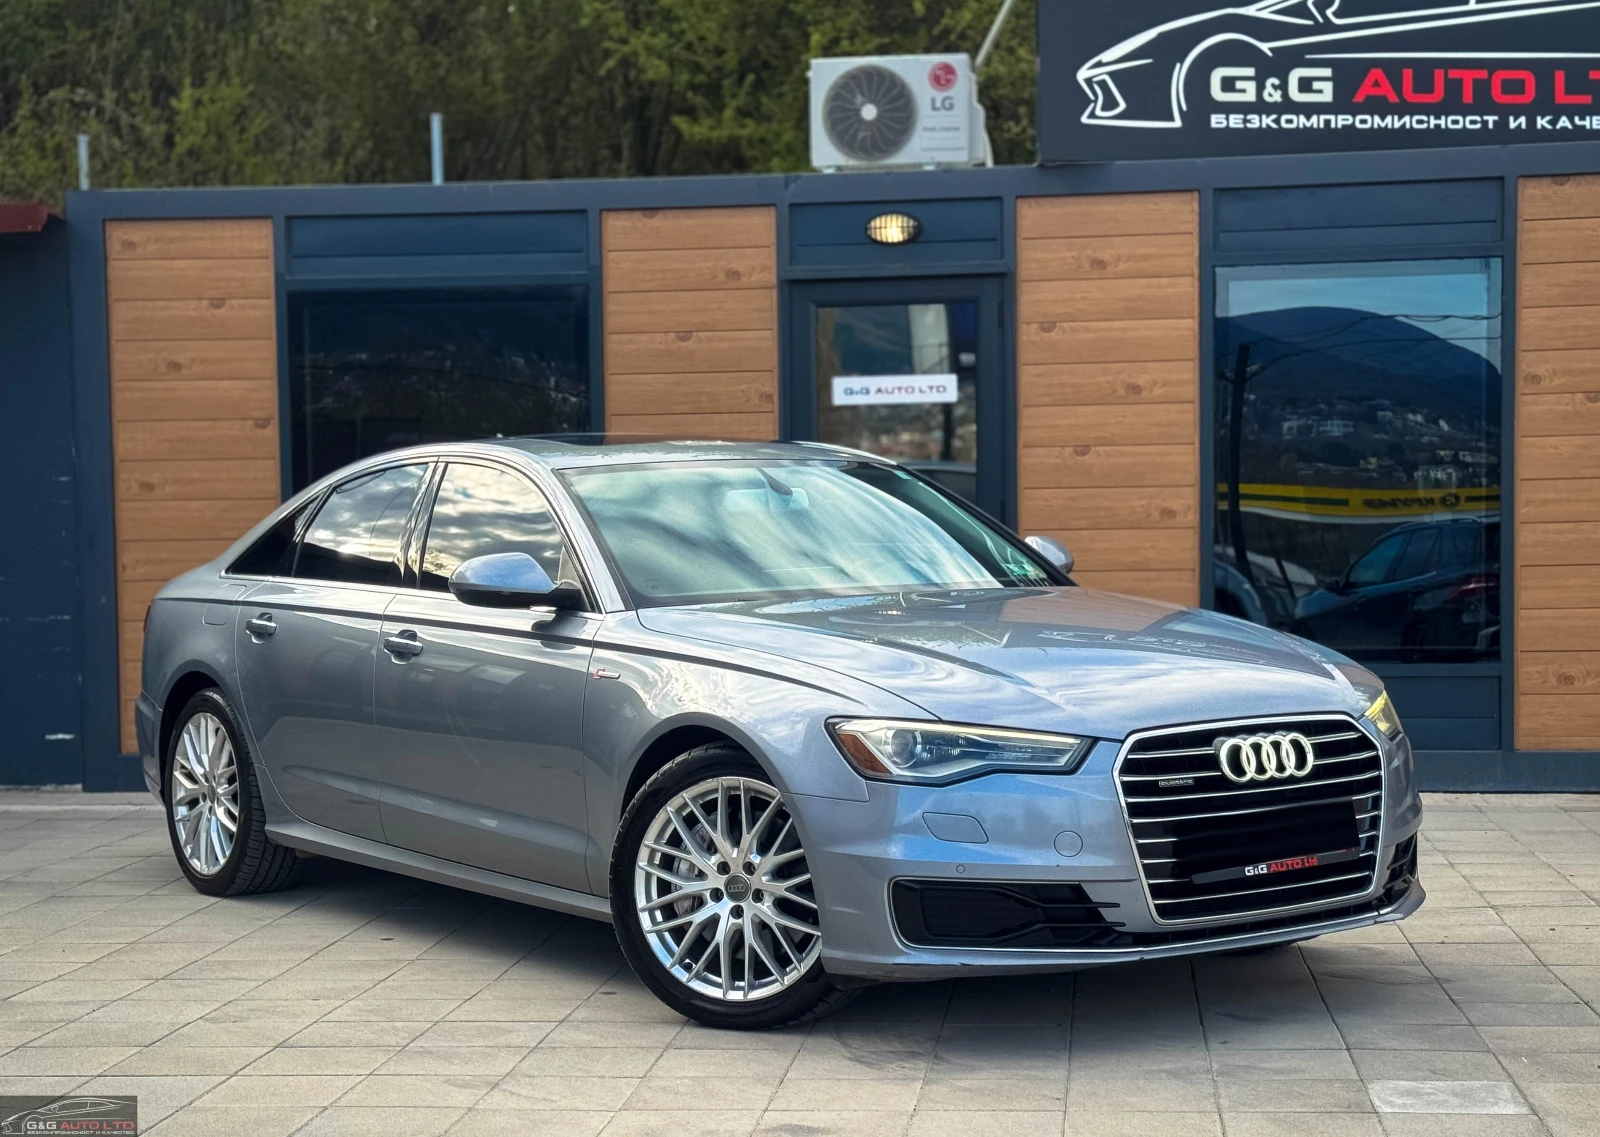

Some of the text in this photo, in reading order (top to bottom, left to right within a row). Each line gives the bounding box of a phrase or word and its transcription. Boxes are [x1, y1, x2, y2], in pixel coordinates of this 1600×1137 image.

[1210, 67, 1600, 104] G&G AUTO L
[930, 96, 954, 111] LG
[1210, 114, 1498, 129] БЕЗКОМПРОМИСНОСТ
[1509, 115, 1526, 129] И
[875, 386, 915, 395] AUTO
[918, 385, 947, 394] LTD
[1245, 864, 1267, 876] G&G
[1270, 859, 1302, 873] AUTO
